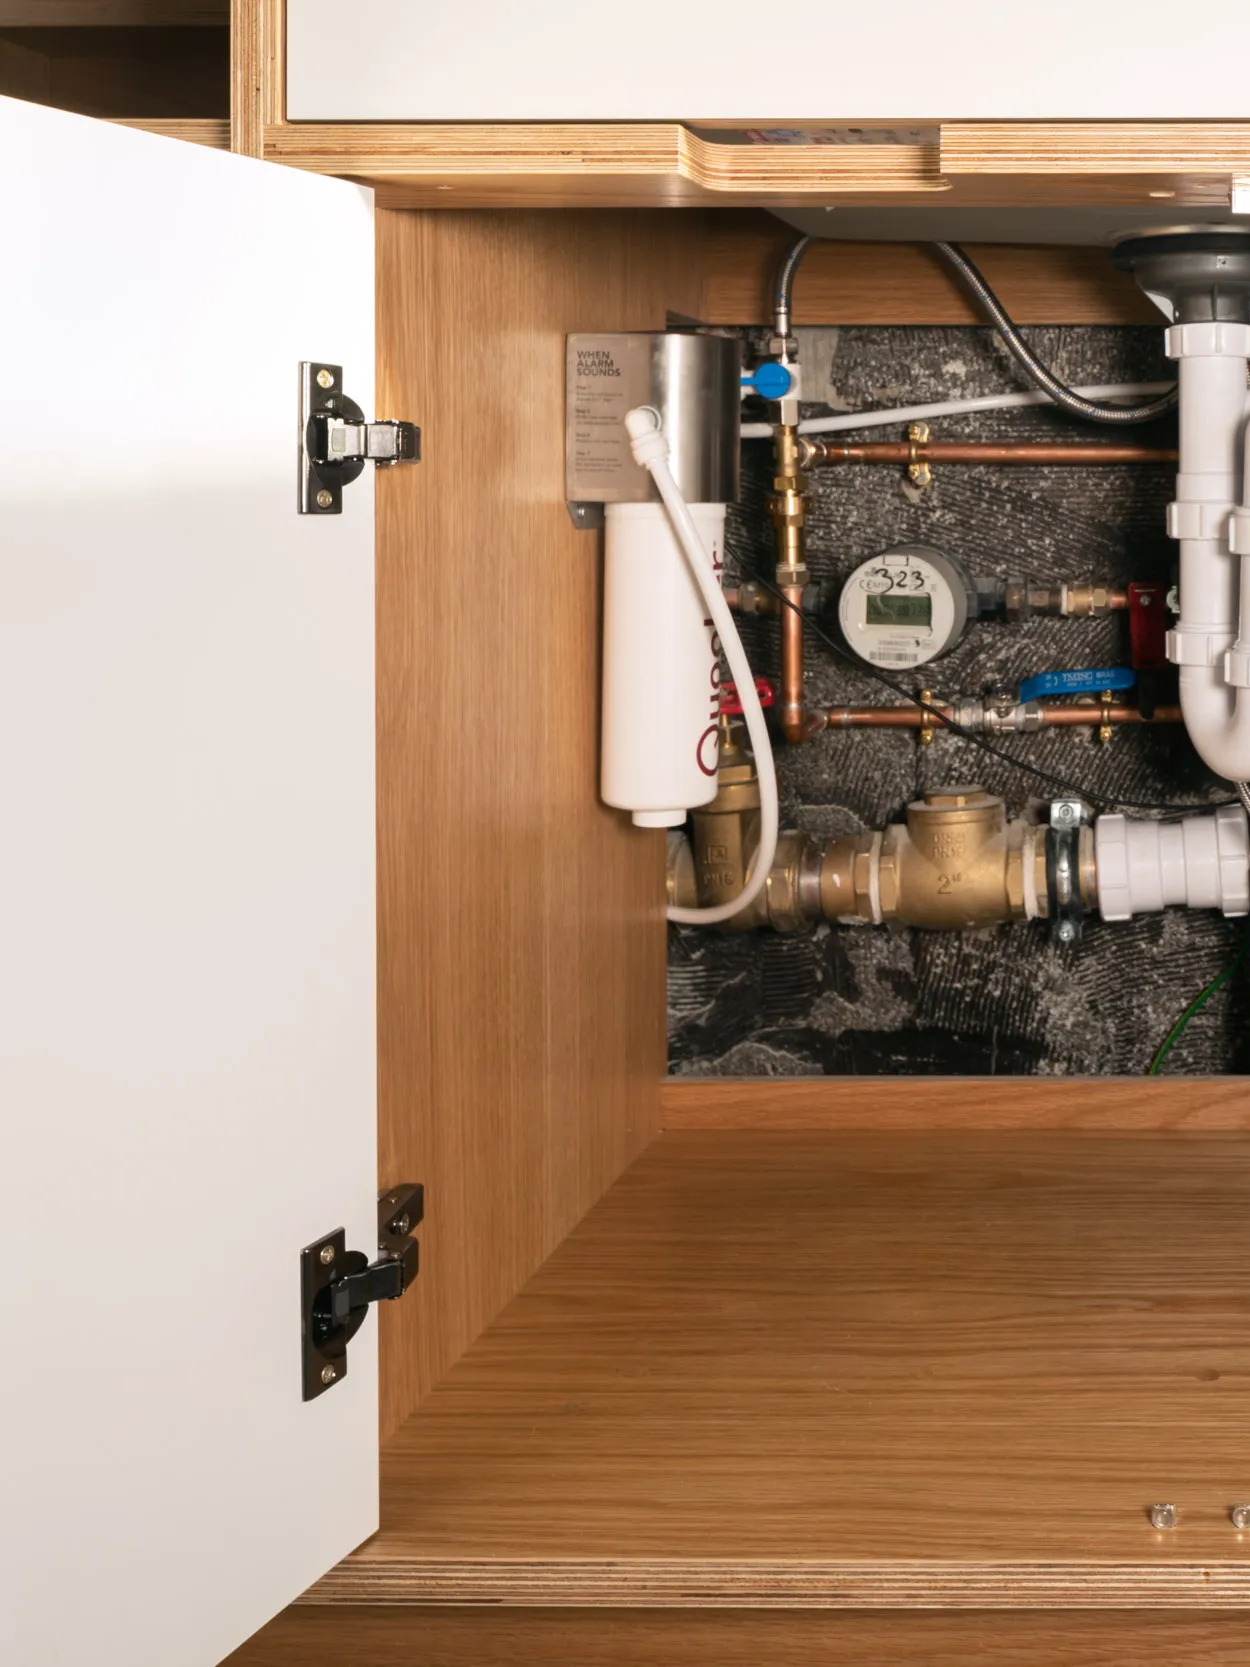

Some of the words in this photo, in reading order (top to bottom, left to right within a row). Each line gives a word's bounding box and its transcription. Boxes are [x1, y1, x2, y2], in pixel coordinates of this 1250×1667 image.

[576, 350, 610, 360] WHEN
[576, 359, 614, 368] ALARM
[576, 368, 621, 377] SOUNDS
[874, 567, 926, 594] 323
